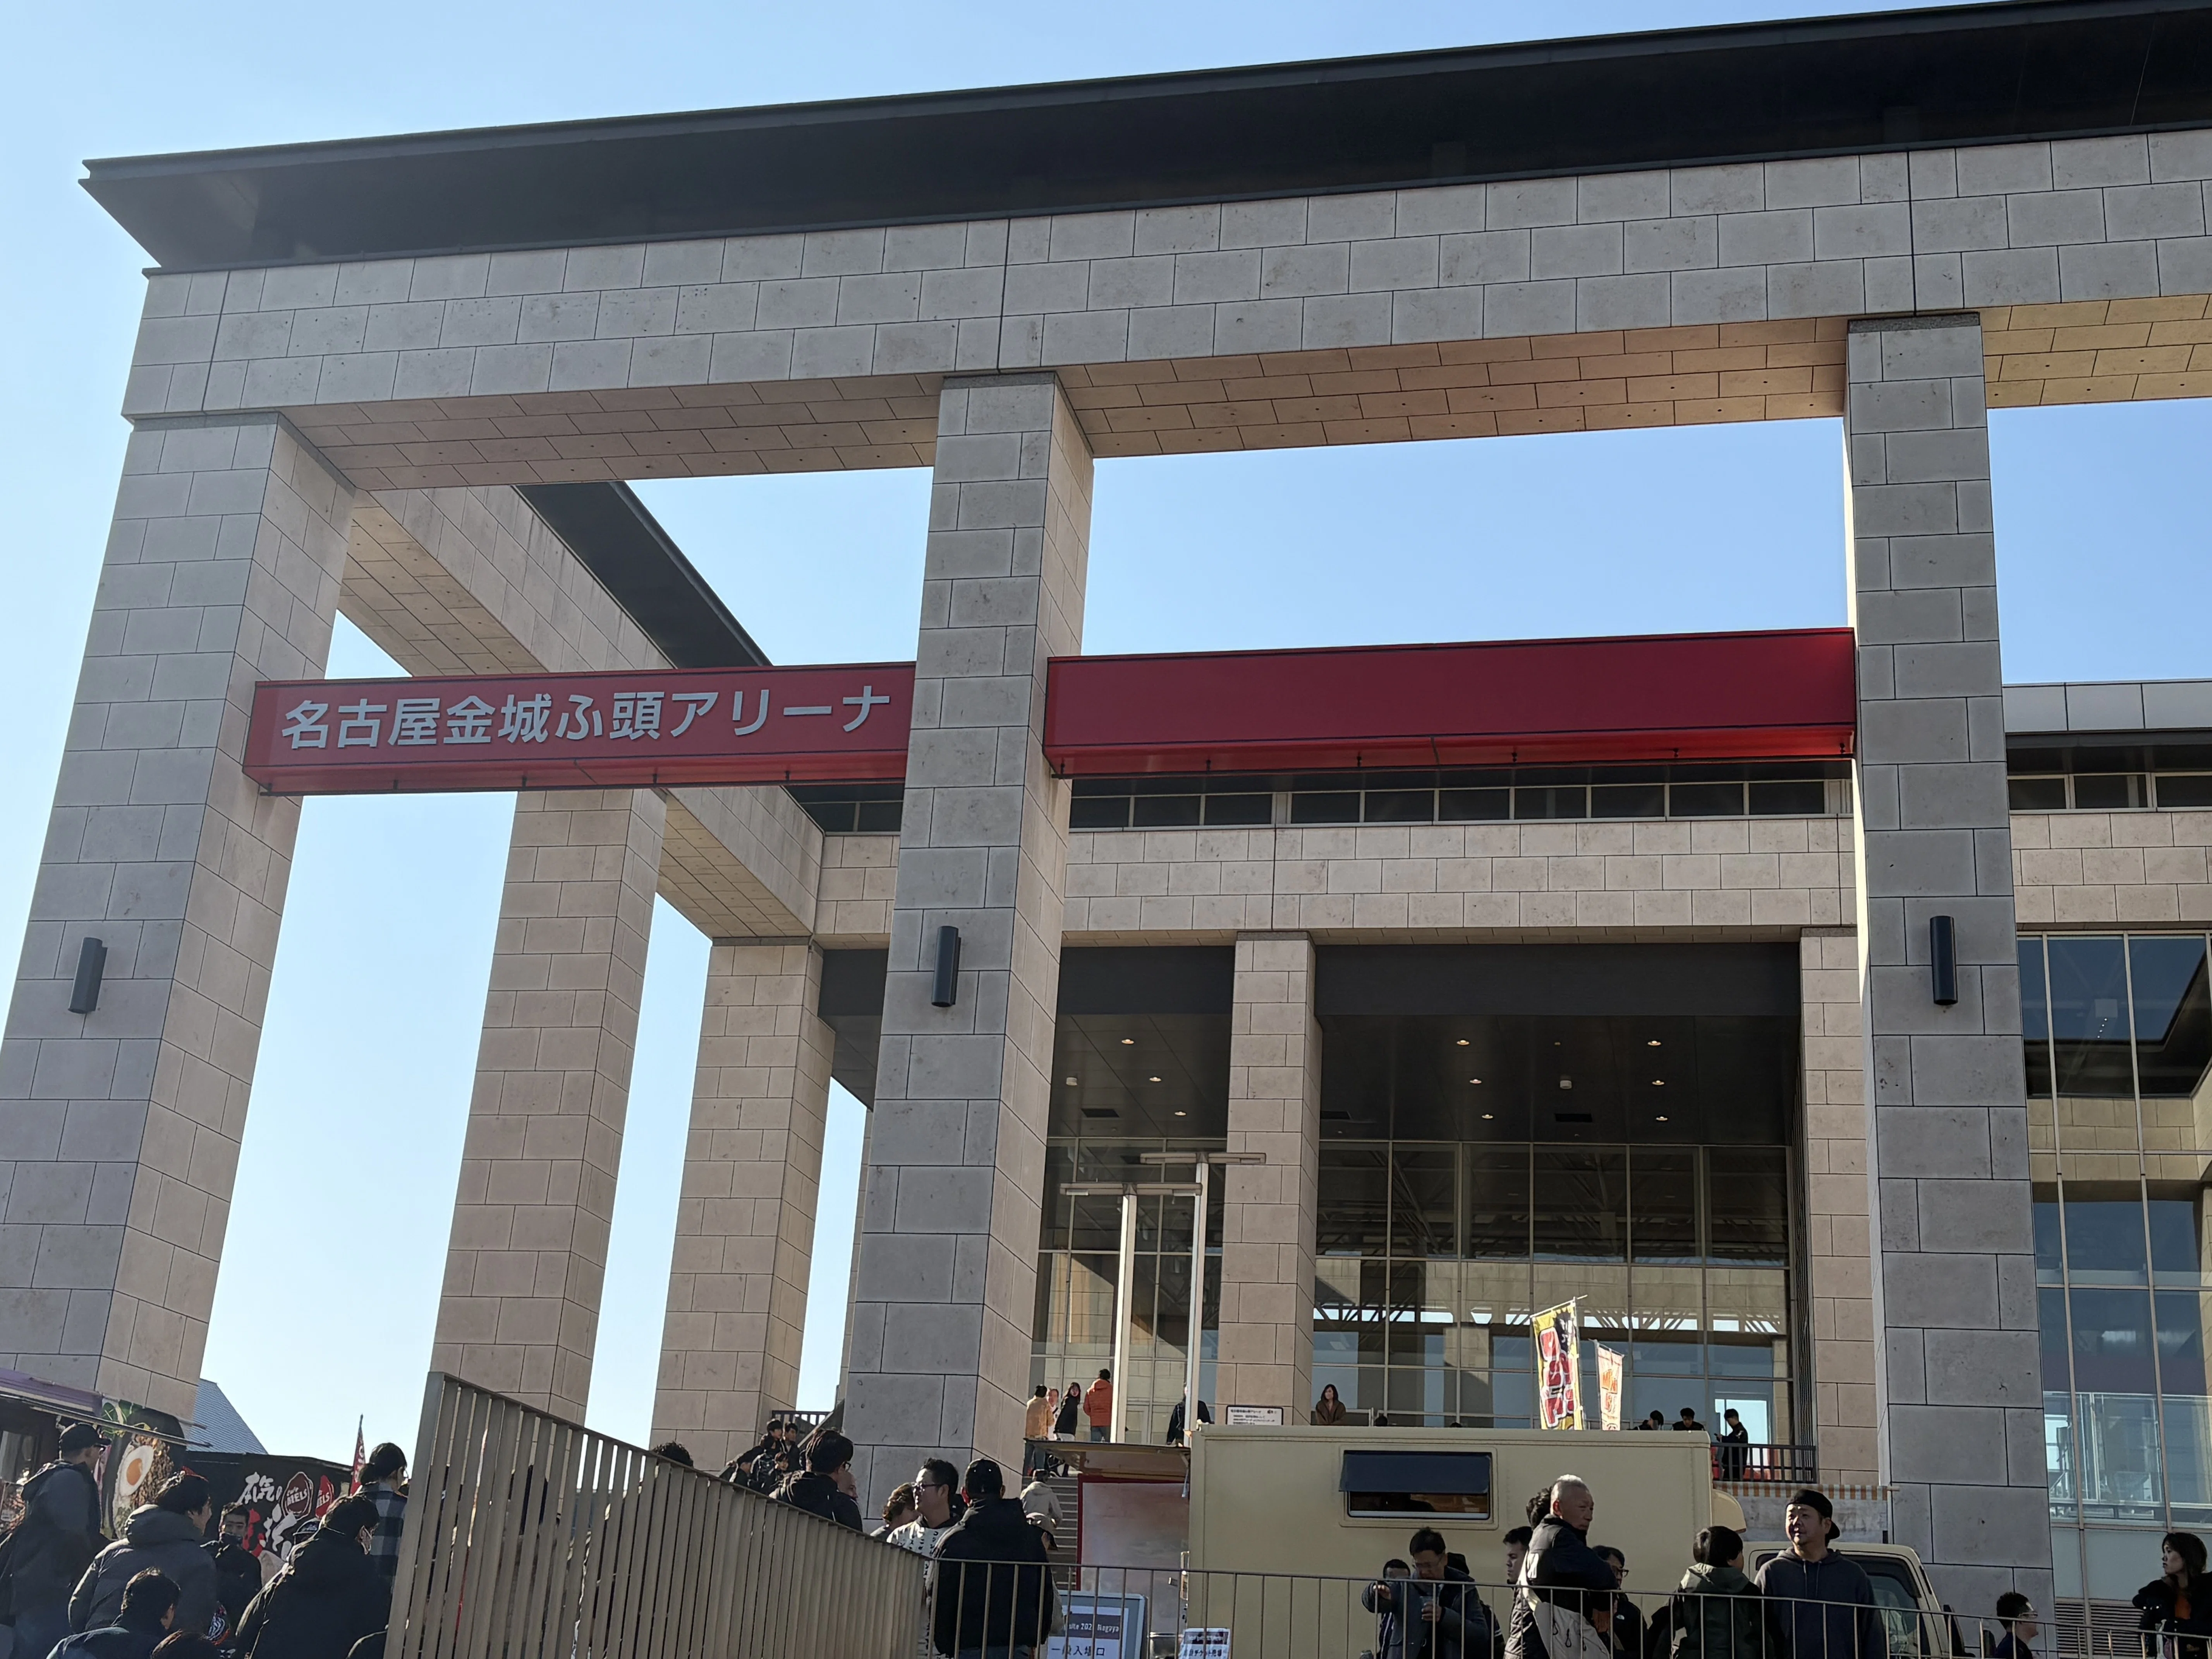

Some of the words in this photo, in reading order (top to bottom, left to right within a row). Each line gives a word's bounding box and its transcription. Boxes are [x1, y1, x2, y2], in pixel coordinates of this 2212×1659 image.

[282, 685, 890, 750] 名古屋金城ふ頭アリーナ
